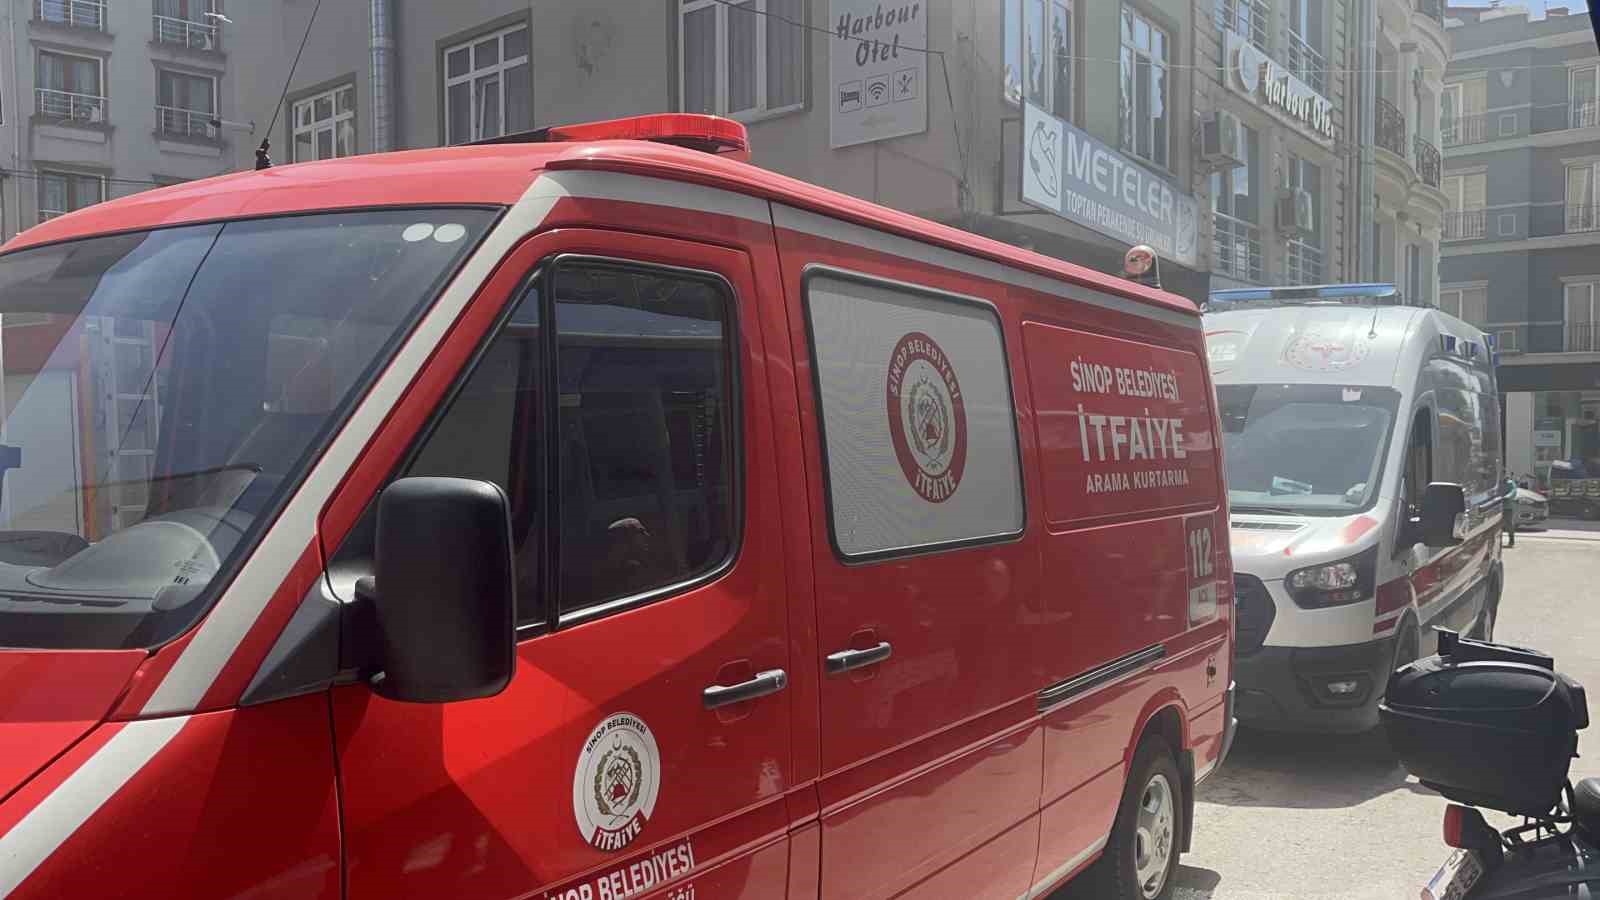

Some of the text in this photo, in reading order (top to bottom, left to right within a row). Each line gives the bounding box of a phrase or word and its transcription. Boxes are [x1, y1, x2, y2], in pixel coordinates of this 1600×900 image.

[837, 3, 919, 41] Harbour
[855, 34, 899, 67] Otel
[1264, 62, 1310, 121] Harbour
[1067, 131, 1173, 225] METELER
[1070, 355, 1180, 401] SİNOP BELEDİYESİ
[1077, 403, 1187, 462] İTFAİYE
[1086, 469, 1190, 494] ARAMA KURTARMA
[1190, 527, 1213, 578] 112
[594, 816, 641, 850] İTFAİYE
[597, 836, 695, 900] BELEDİYESİ
